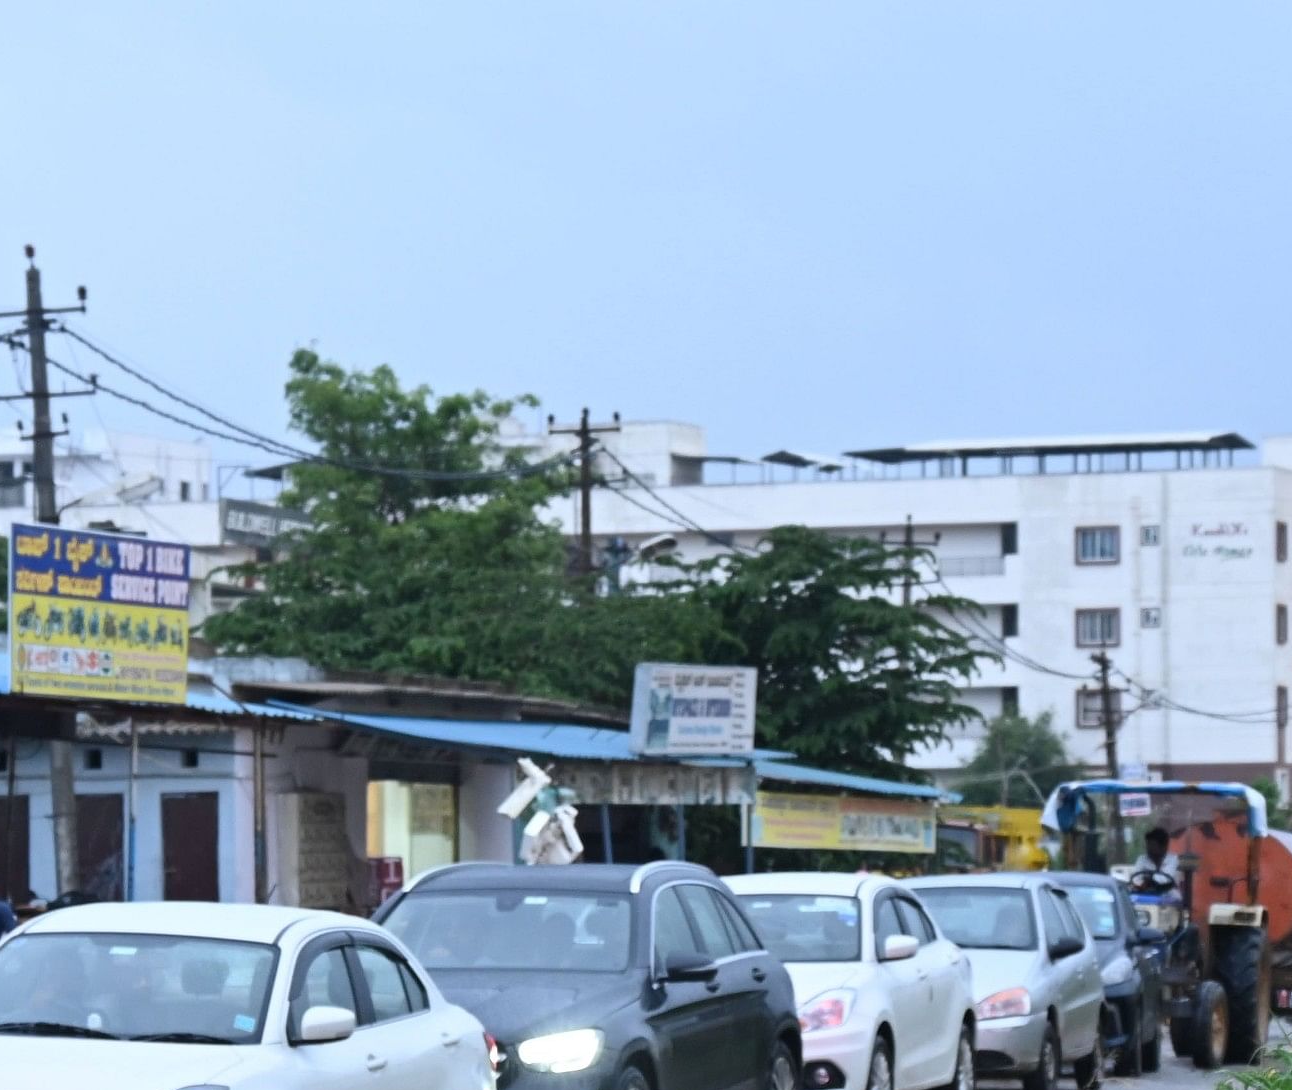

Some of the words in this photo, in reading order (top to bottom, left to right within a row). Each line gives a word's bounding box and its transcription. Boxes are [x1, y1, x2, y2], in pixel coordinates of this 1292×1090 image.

[118, 541, 144, 571] TOP
[155, 546, 185, 576] BIKE
[110, 574, 156, 603] SERVICE
[157, 579, 189, 607] POINT
